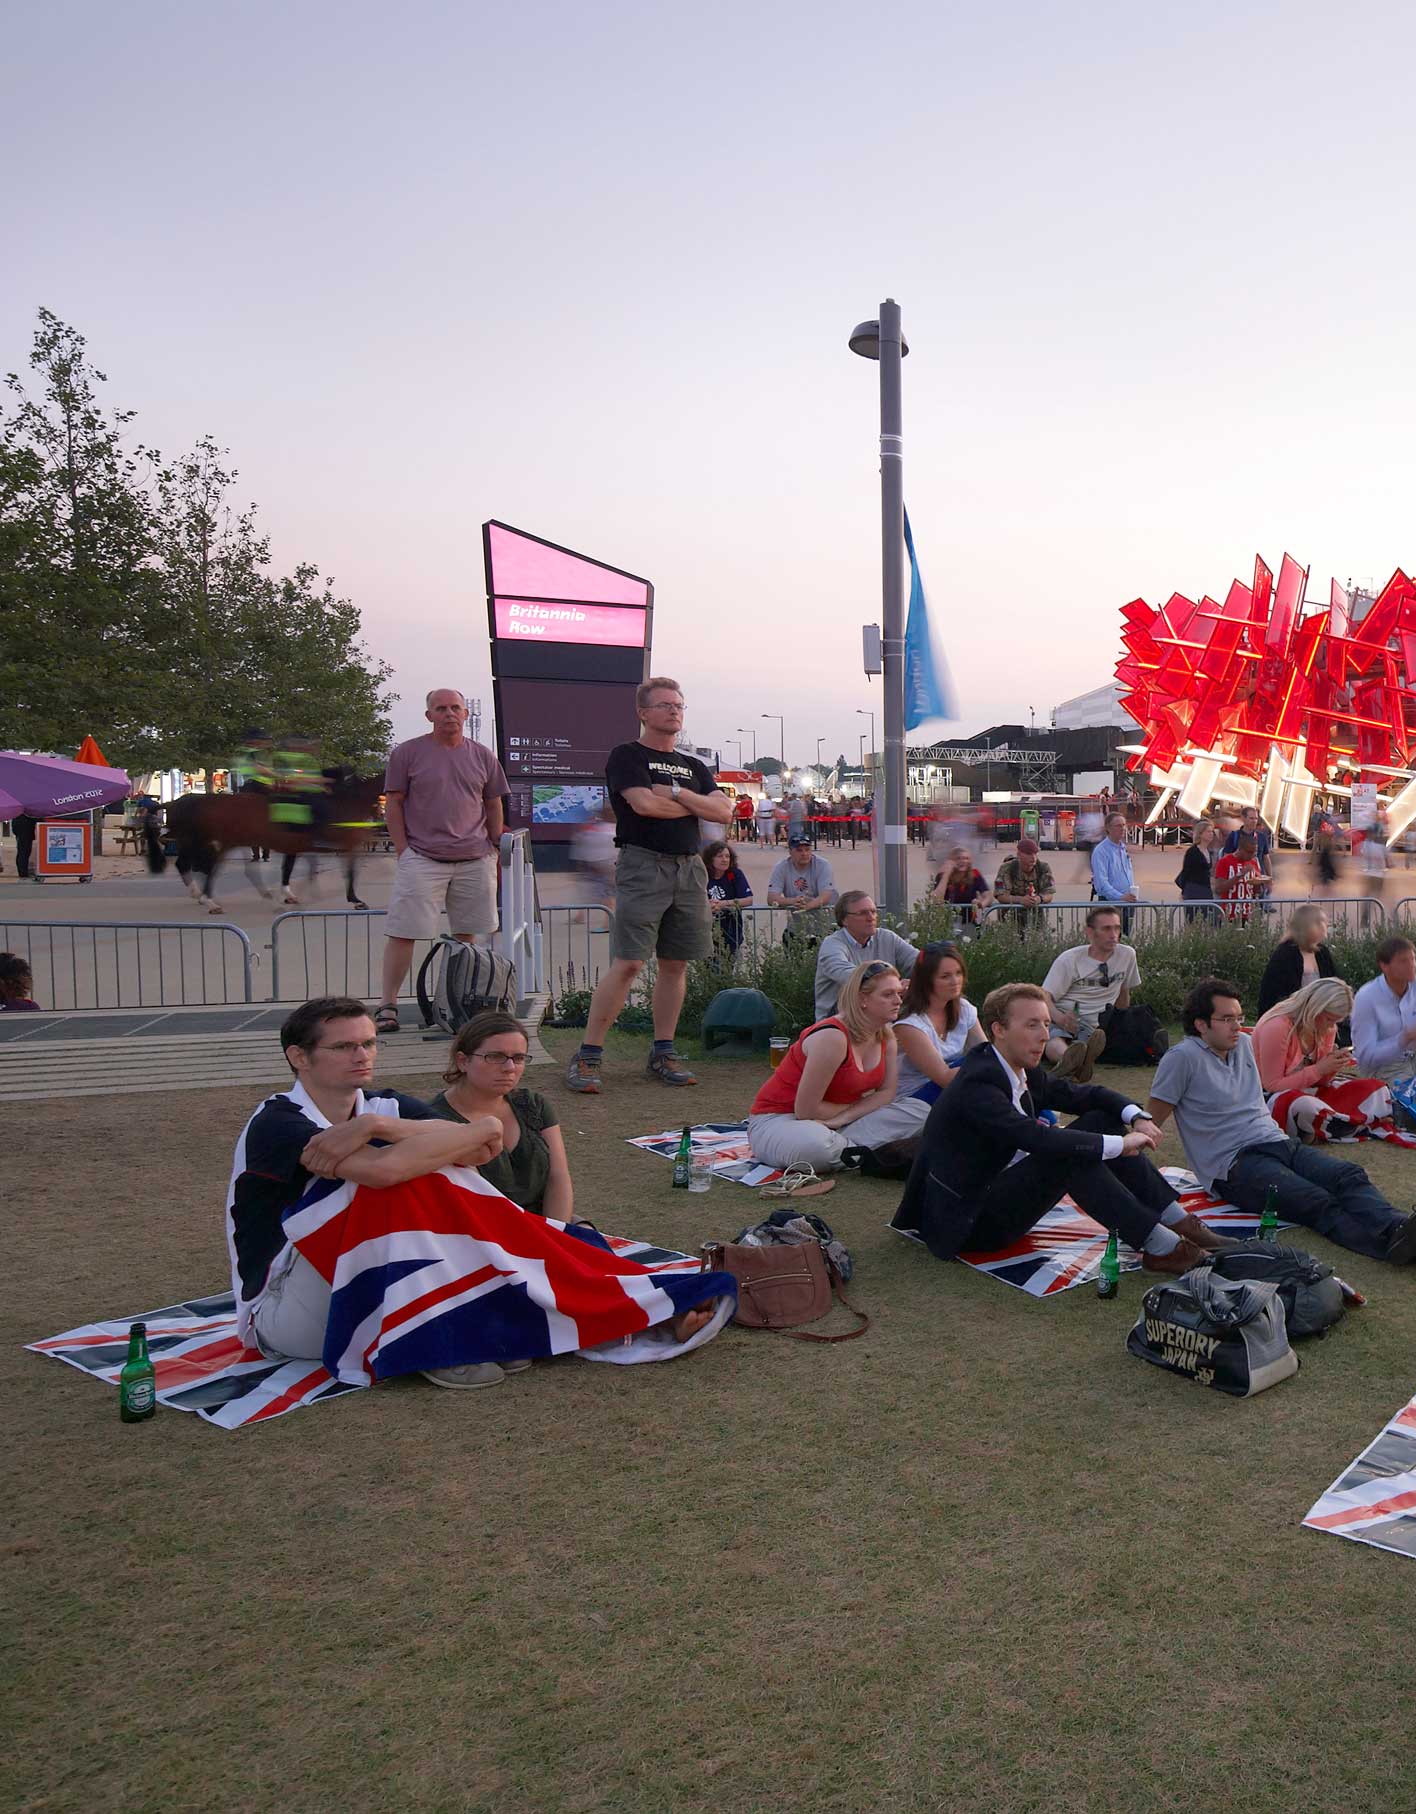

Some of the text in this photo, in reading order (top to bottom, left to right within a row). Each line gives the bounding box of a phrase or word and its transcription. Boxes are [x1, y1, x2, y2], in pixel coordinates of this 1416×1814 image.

[509, 604, 586, 622] Britannia
[509, 621, 546, 635] Row
[52, 789, 104, 805] London 2012
[1145, 1319, 1222, 1360] SUPERDRY
[1161, 1345, 1198, 1372] JAPAN
